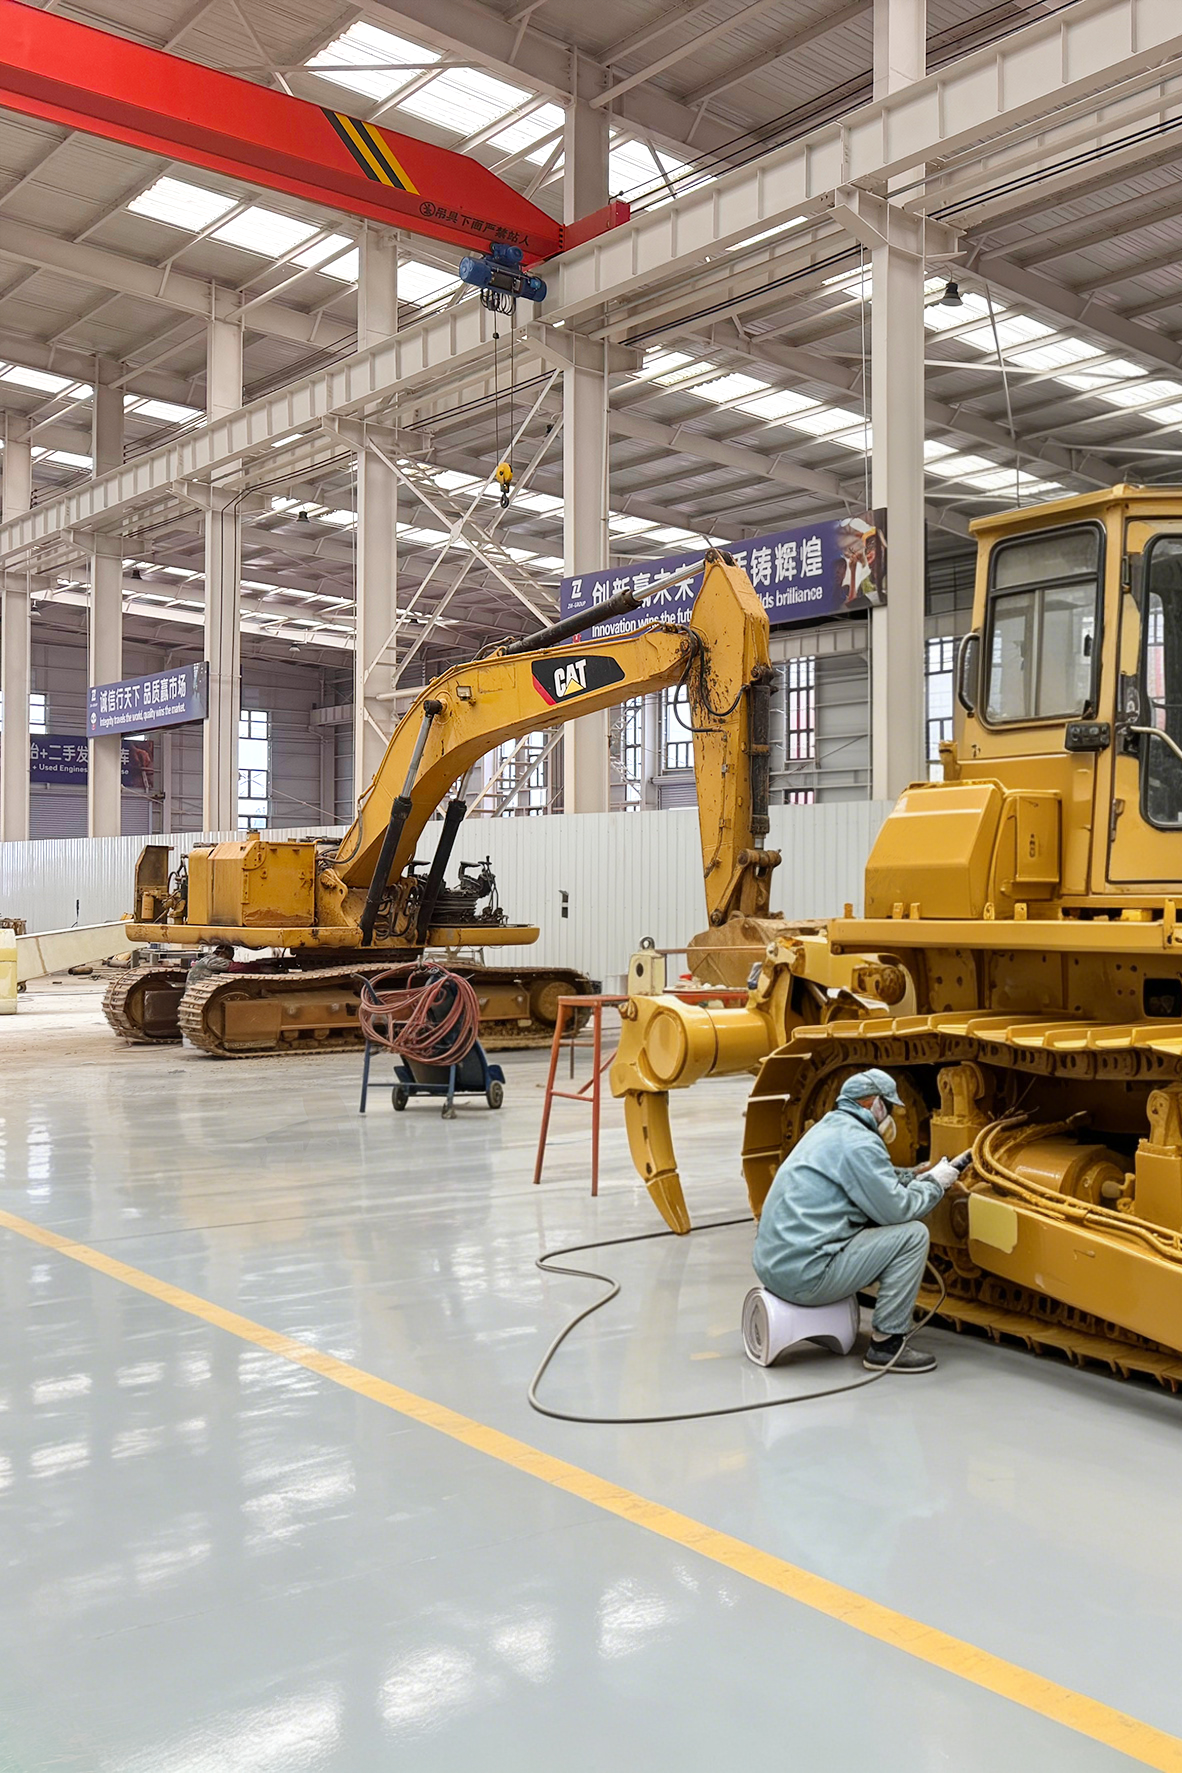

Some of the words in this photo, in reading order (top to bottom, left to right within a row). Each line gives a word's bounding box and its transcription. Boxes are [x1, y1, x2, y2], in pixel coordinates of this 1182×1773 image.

[434, 207, 529, 246] 吊具下面严禁站人
[592, 618, 637, 638] Innovation
[776, 586, 823, 607] brilliance
[143, 673, 186, 705] 品质赢市场
[554, 659, 587, 698] CAT
[39, 763, 58, 771] Used
[59, 764, 88, 774] Engines
